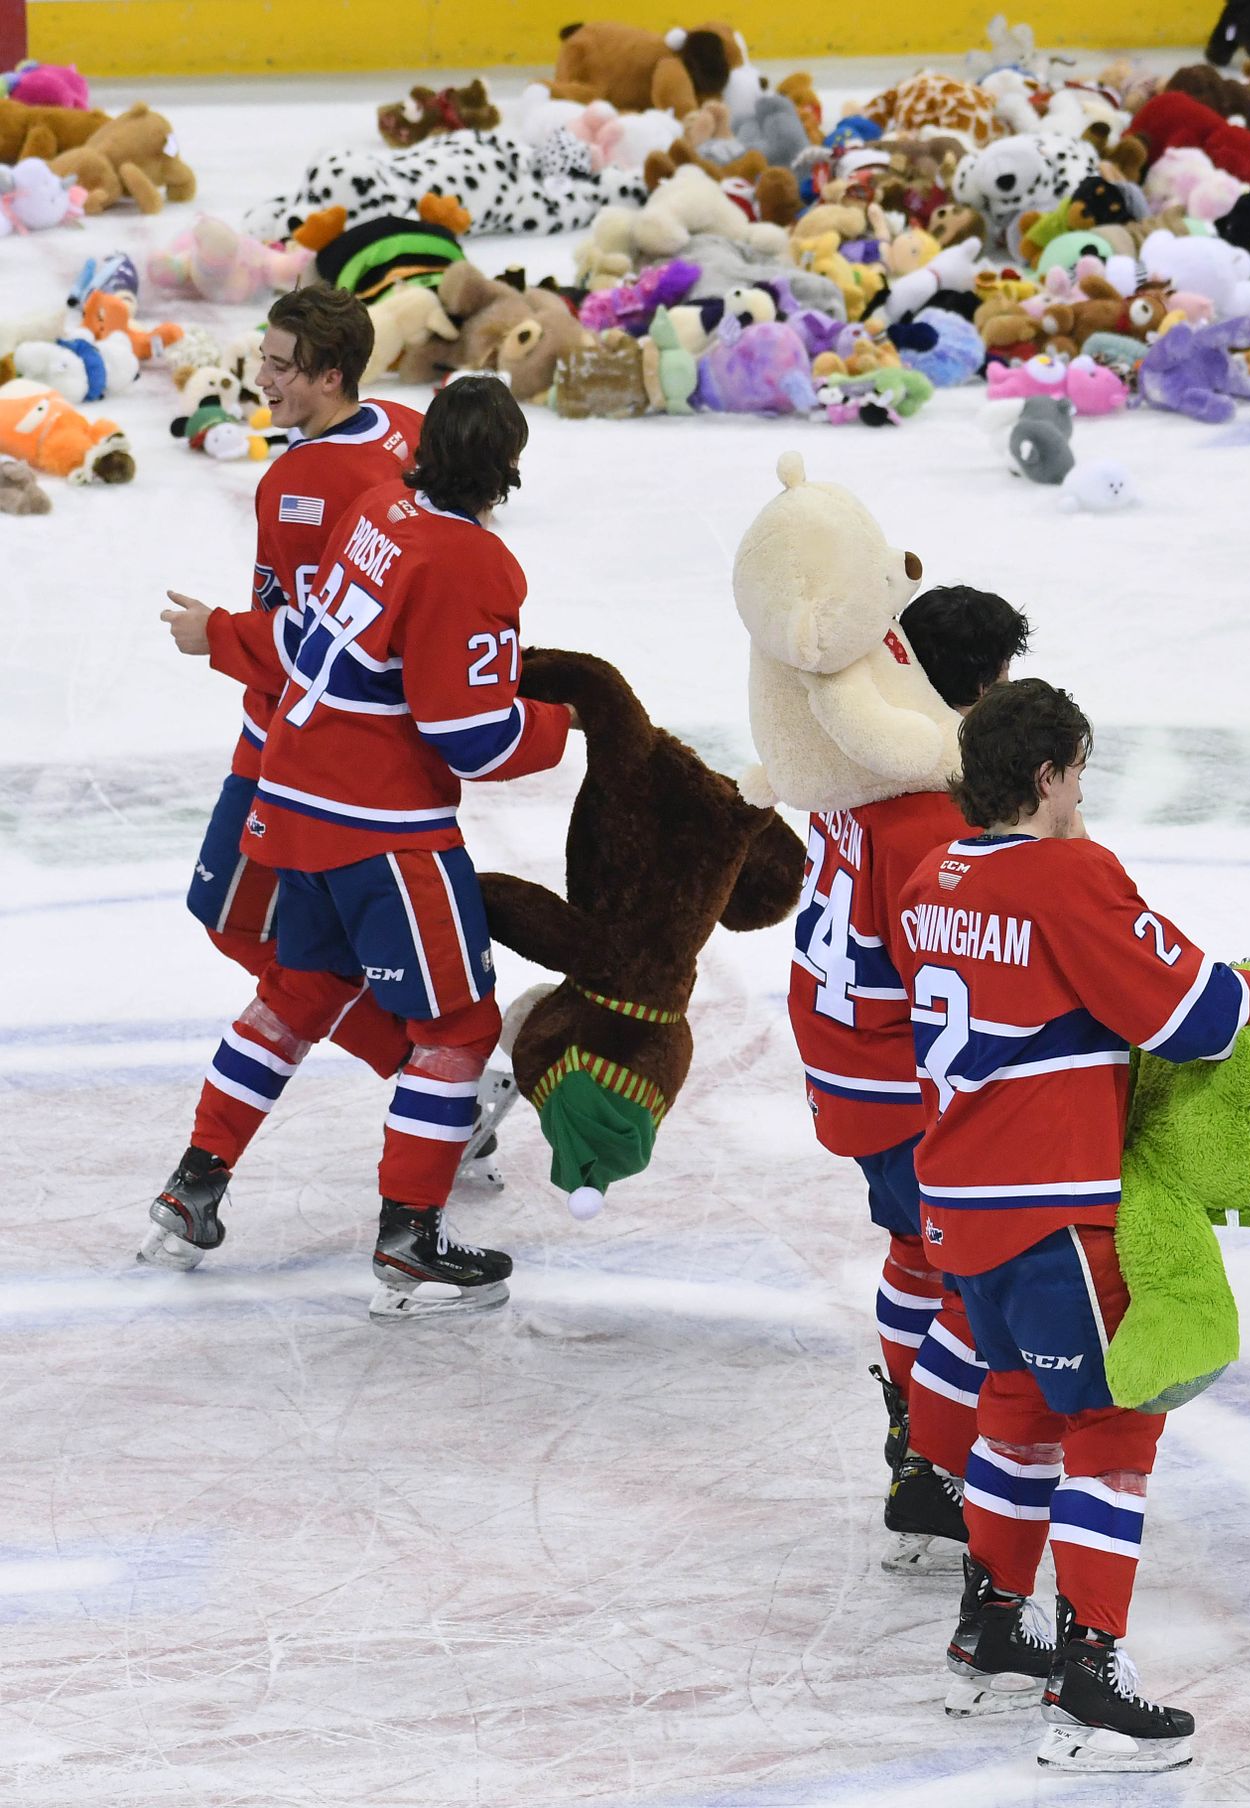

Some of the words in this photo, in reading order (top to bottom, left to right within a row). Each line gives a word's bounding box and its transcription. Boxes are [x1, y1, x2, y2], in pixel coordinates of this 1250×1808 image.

[383, 431, 403, 451] CCM
[398, 500, 419, 517] CCM
[343, 514, 402, 588] PROSKE
[467, 627, 519, 687] 27
[939, 860, 971, 874] CCM
[900, 903, 1032, 967] CNINGHAM
[1133, 911, 1182, 967] 2
[361, 964, 405, 982] CM
[914, 963, 970, 1117] 2
[1019, 1348, 1084, 1370] CCM
